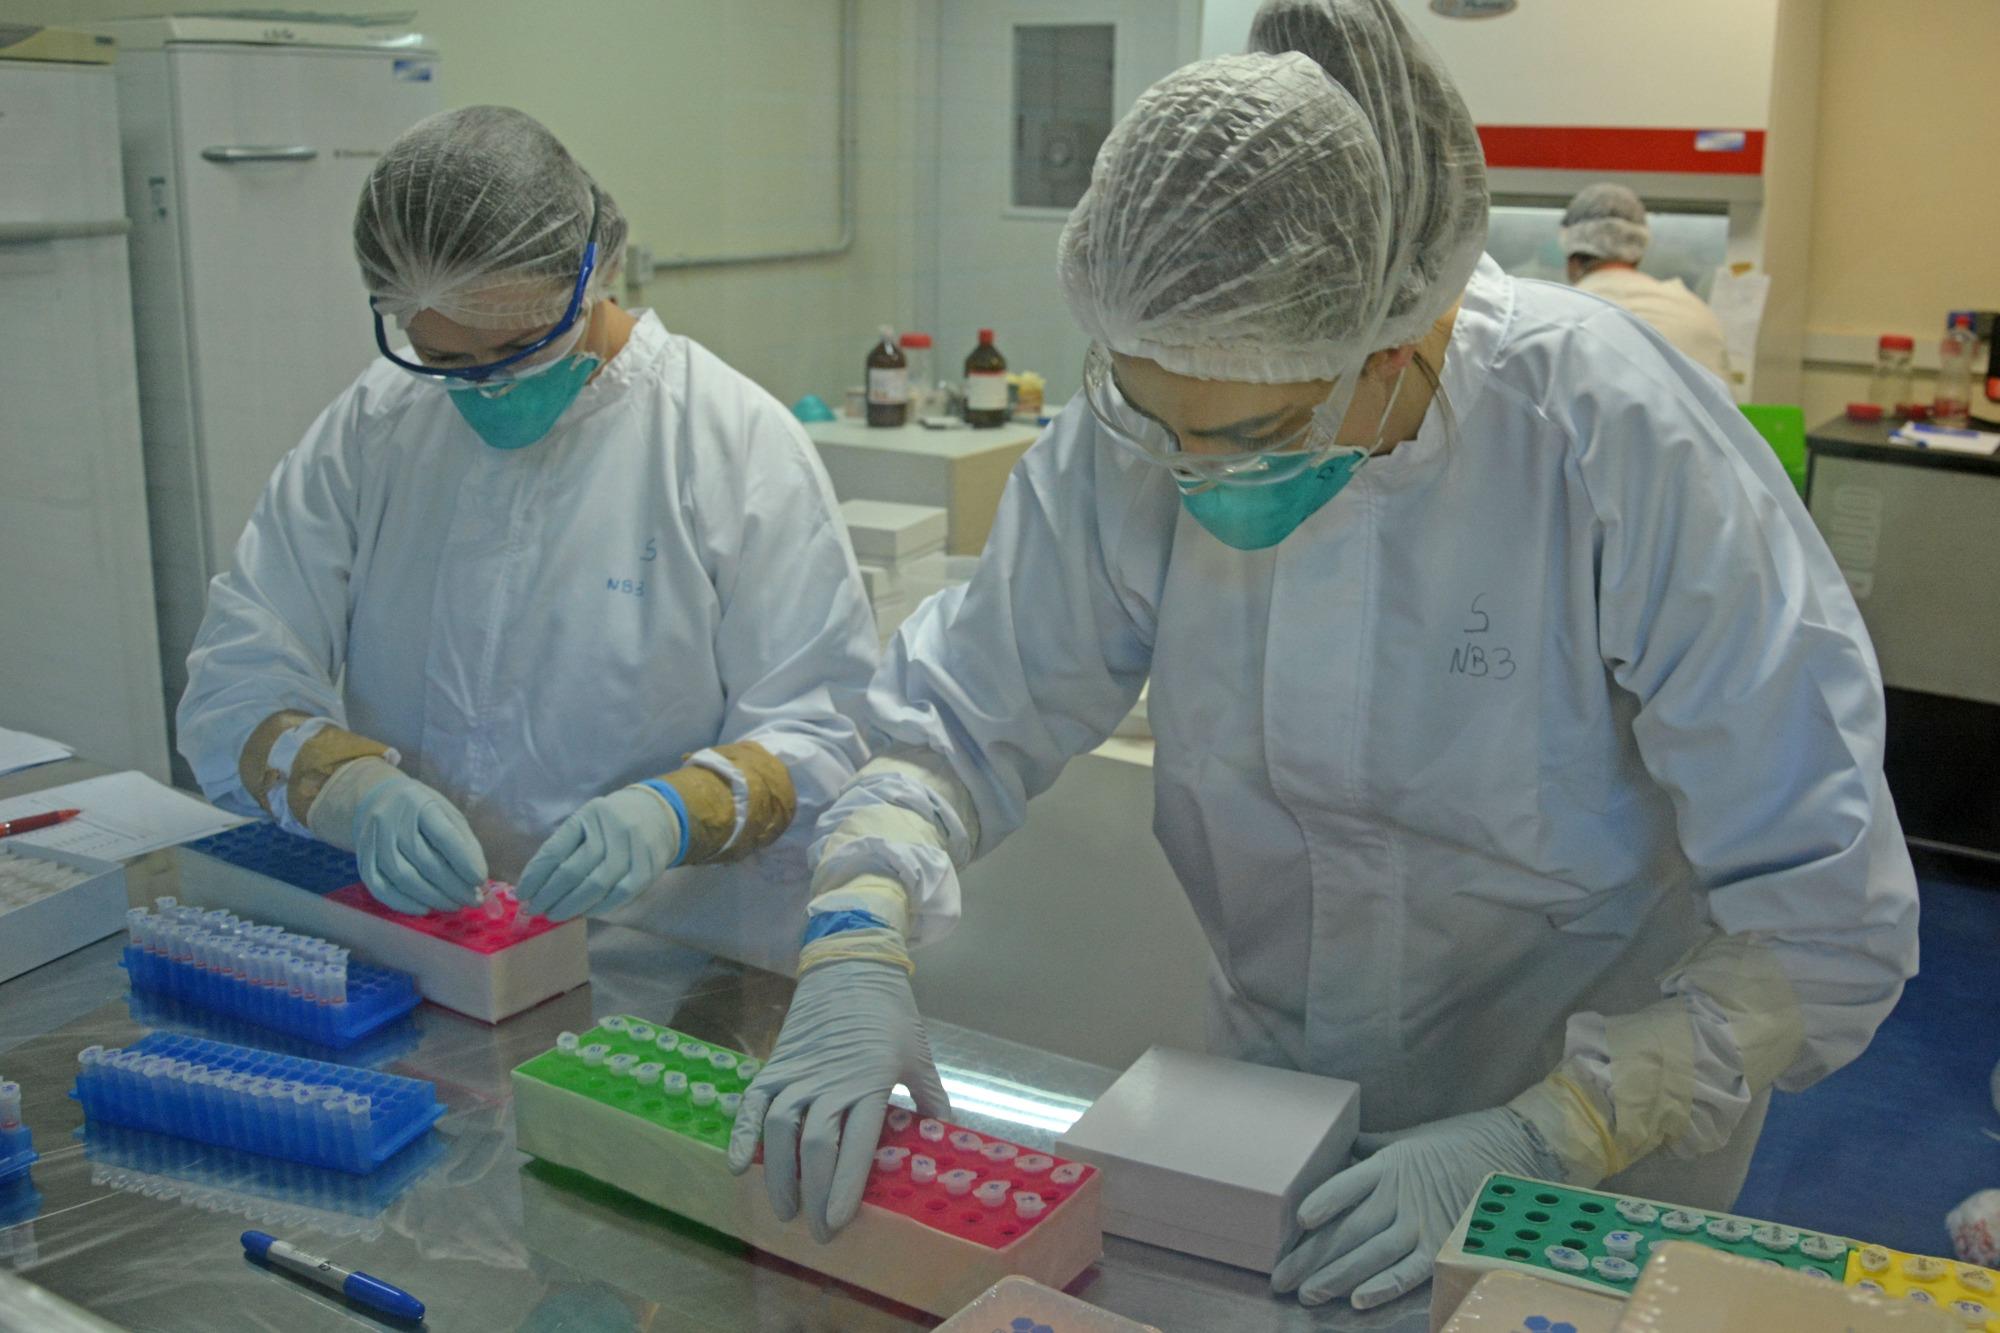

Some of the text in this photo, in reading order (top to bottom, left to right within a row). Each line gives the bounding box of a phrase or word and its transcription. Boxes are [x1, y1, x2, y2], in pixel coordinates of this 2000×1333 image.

[640, 537, 657, 561] S
[1463, 592, 1489, 632] S
[1448, 642, 1516, 680] NB3
